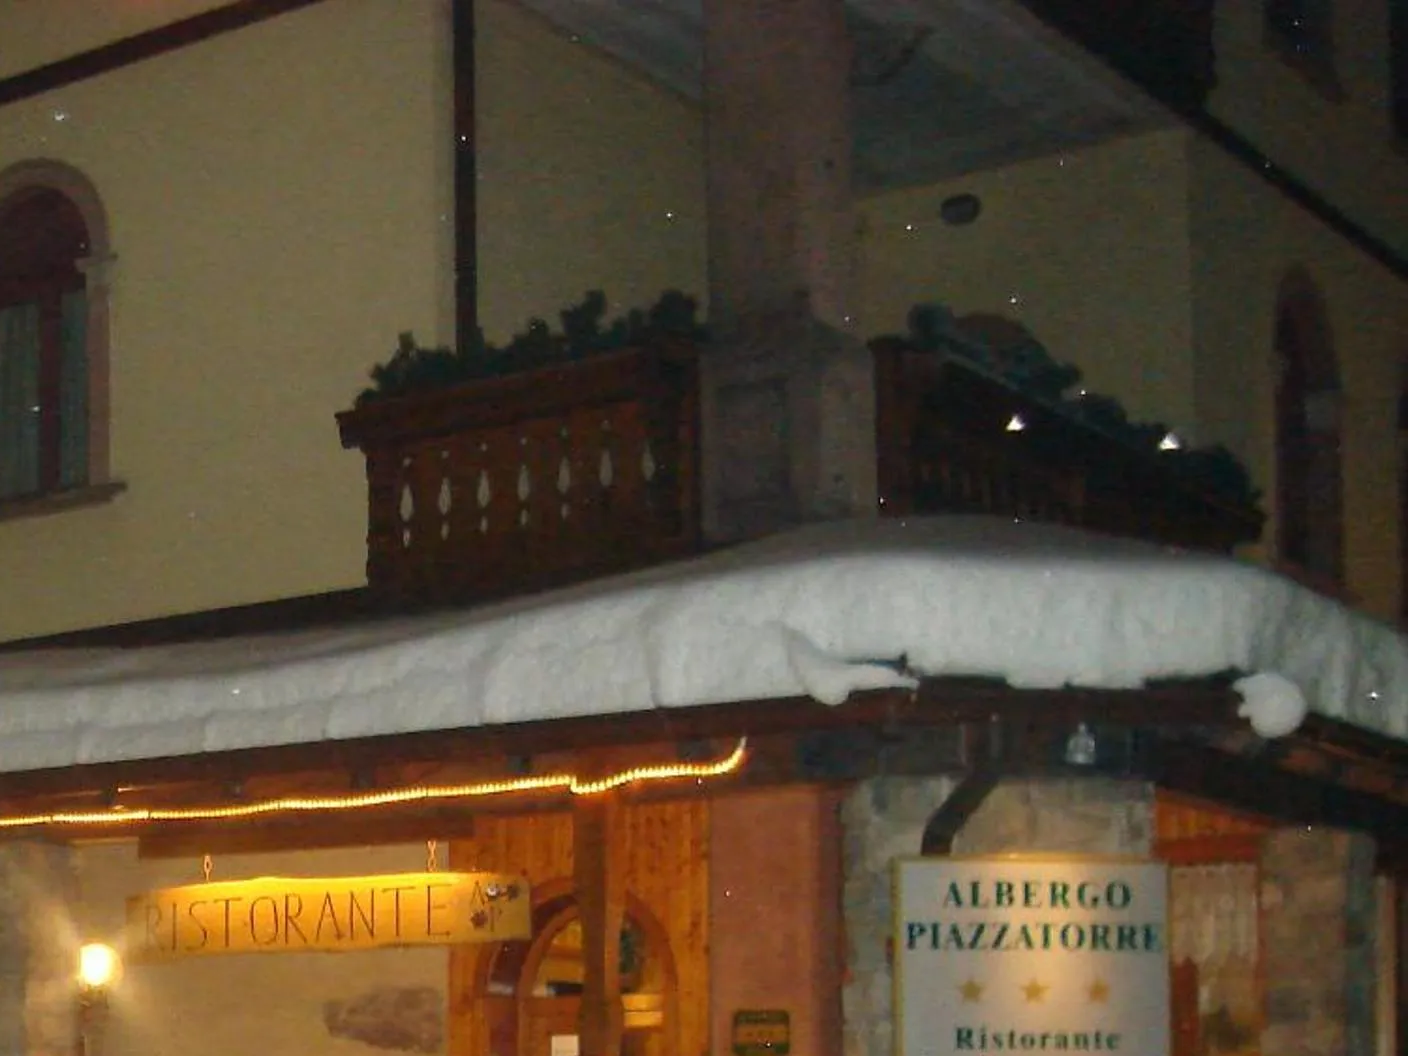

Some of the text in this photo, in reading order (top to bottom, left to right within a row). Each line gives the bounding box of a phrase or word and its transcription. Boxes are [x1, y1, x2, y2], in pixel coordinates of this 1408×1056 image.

[943, 879, 1133, 910] ALBERGO
[141, 883, 452, 952] RISTORANTE
[906, 921, 1163, 951] PIAZZATORRE
[954, 1025, 1122, 1051] Ristorante
